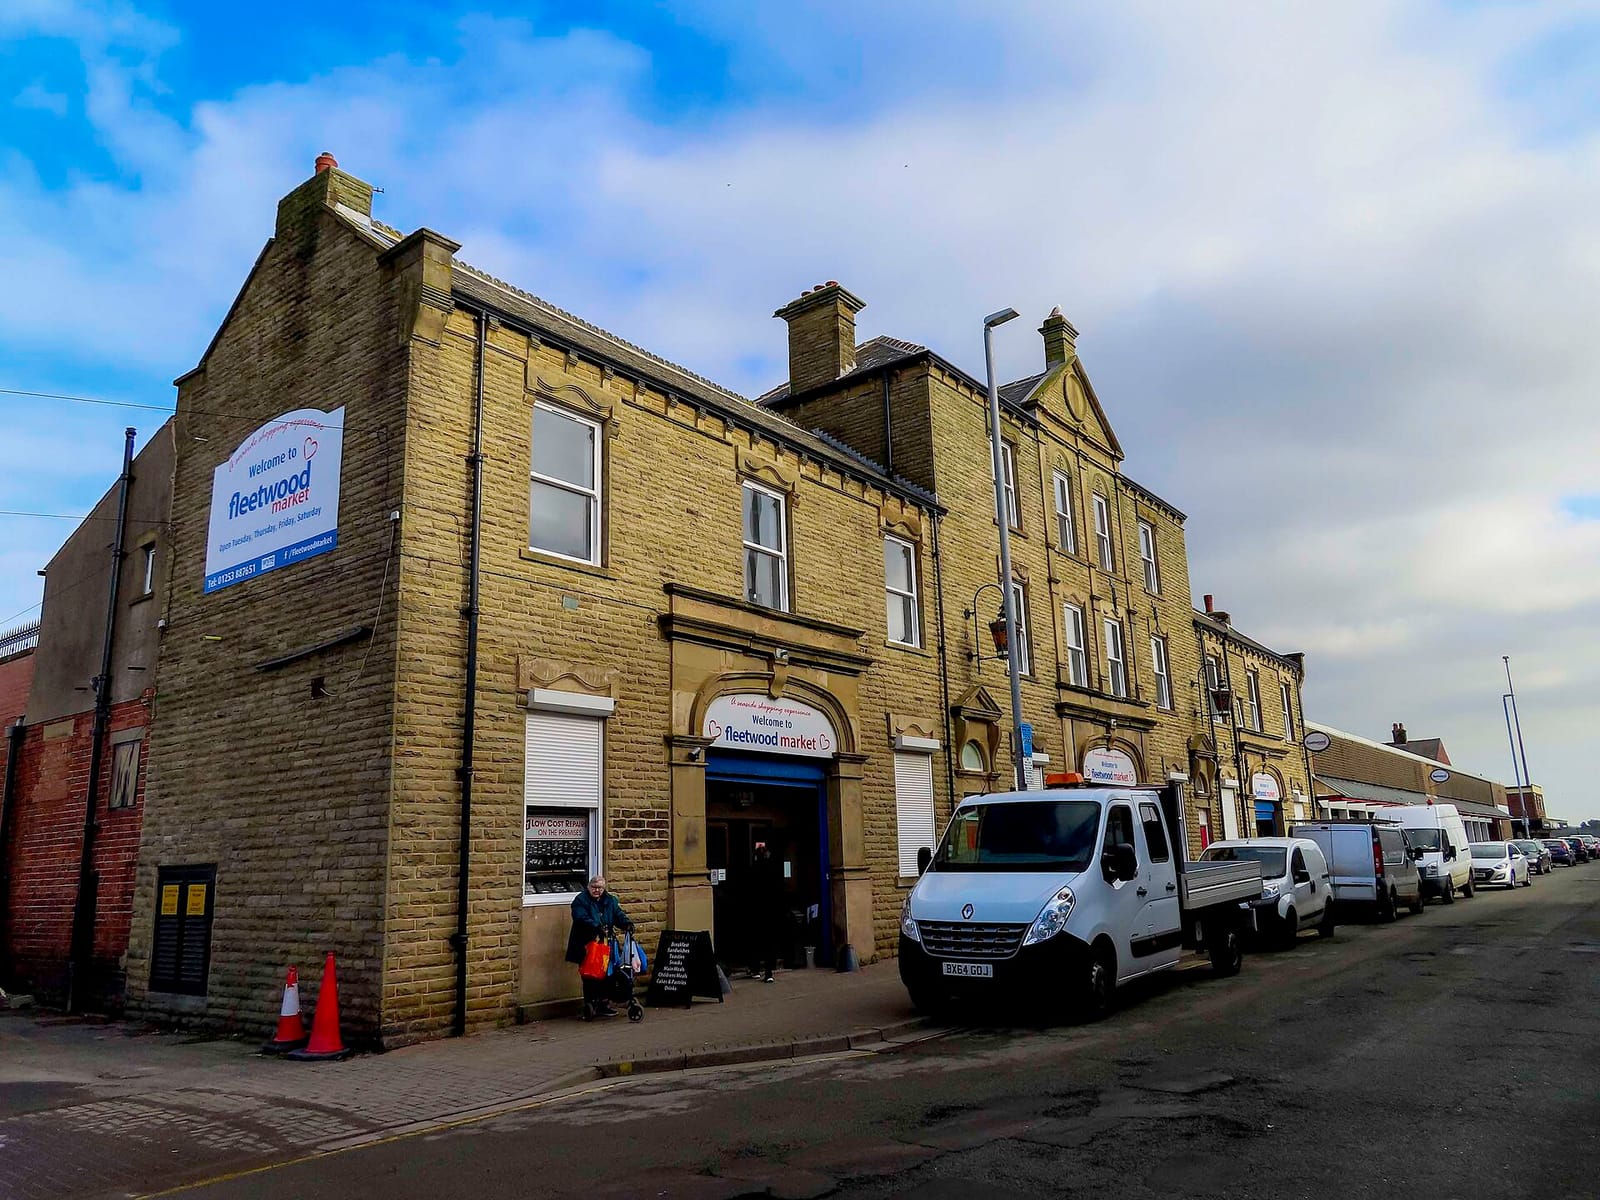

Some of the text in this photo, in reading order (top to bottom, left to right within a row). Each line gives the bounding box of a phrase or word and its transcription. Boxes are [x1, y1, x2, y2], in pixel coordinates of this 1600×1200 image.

[248, 447, 297, 478] Welcome to
[228, 460, 311, 520] fleetwood
[271, 488, 310, 514] market
[297, 506, 322, 522] Saturday
[217, 569, 234, 585] 01253
[235, 563, 256, 579] 887651
[759, 702, 783, 716] shopping
[752, 714, 793, 729] Welcome to
[725, 725, 817, 751] fleetwood market
[531, 819, 546, 828] LOW
[547, 819, 565, 828] COST
[558, 829, 582, 837] PREMISES
[946, 963, 989, 976] BX64 GOJ
